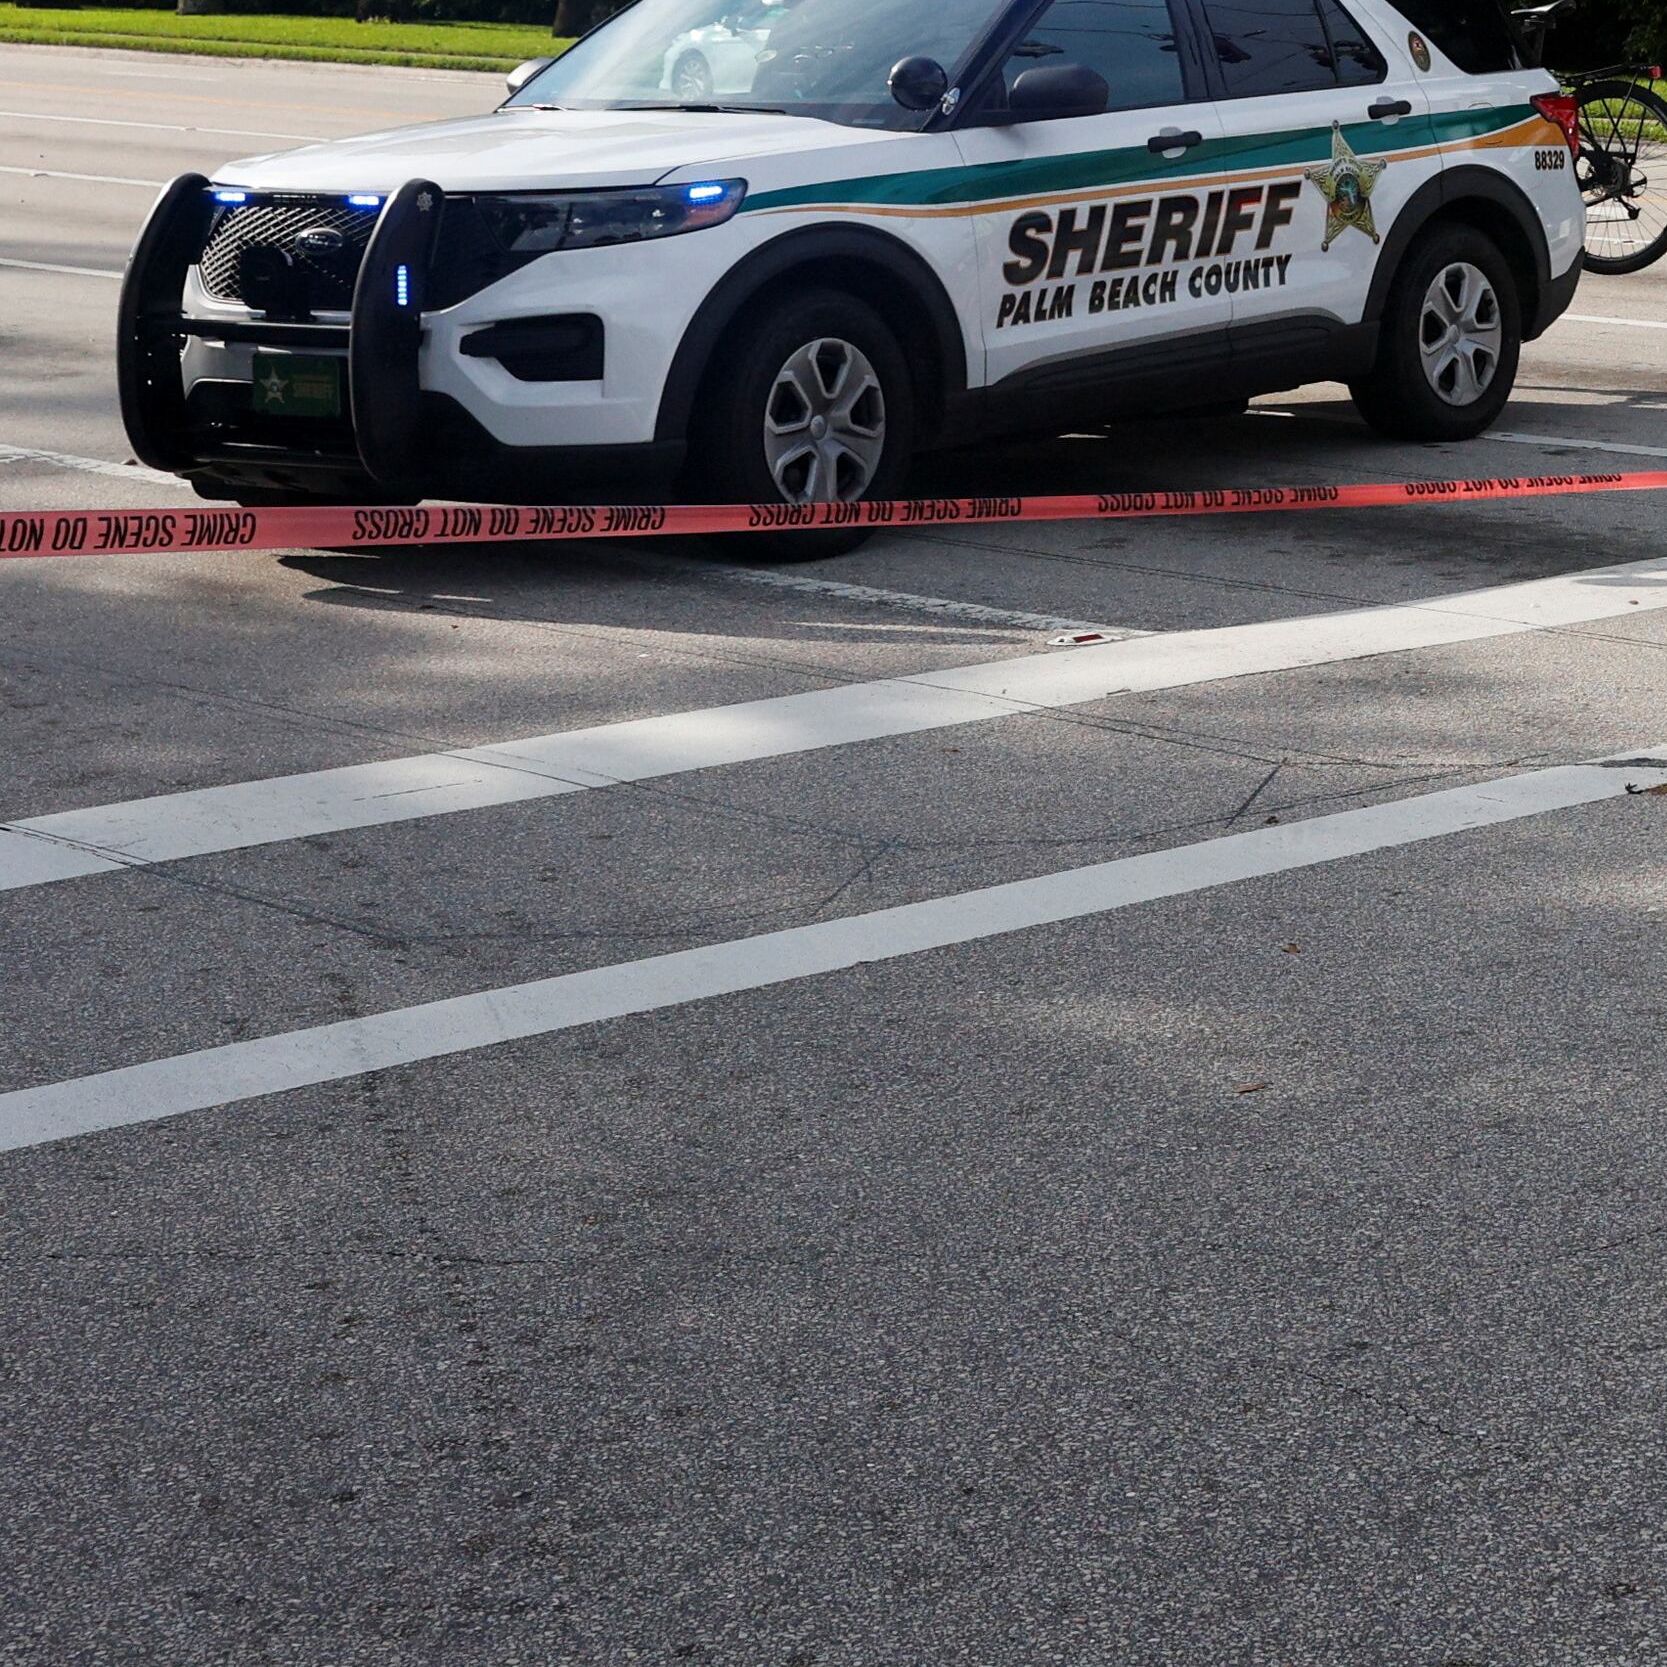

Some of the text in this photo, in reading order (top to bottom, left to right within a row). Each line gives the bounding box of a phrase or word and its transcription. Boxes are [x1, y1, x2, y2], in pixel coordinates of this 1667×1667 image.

[1534, 150, 1565, 171] 88329
[1002, 180, 1303, 287] SHERIFF
[996, 254, 1292, 329] PALM BEACH COUNTY
[52, 517, 88, 550] DO
[94, 515, 177, 549] SCENE
[181, 512, 257, 546] CRIME
[352, 506, 666, 540] CRIME SCENE DO NOT CROSS
